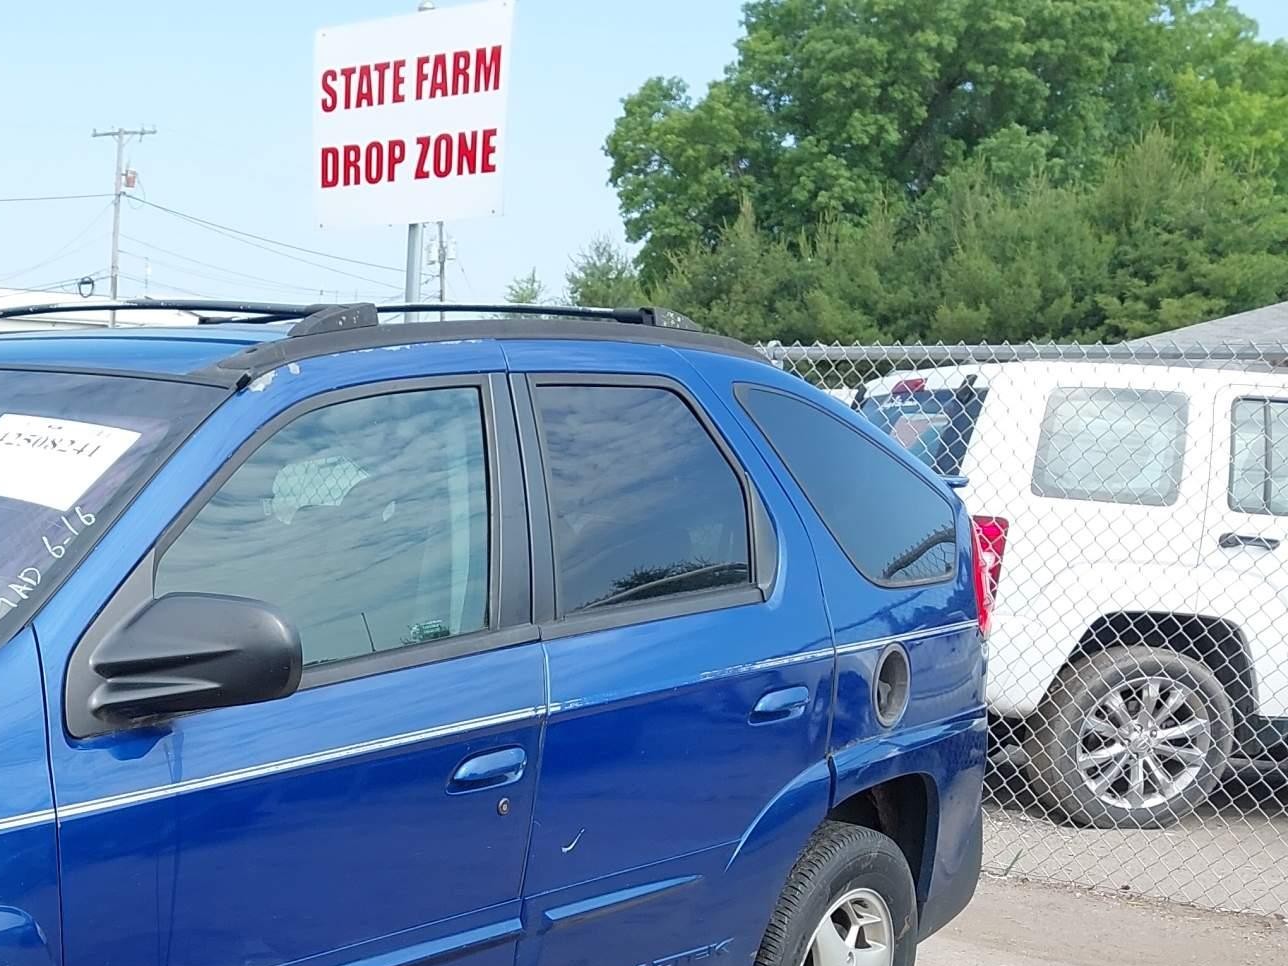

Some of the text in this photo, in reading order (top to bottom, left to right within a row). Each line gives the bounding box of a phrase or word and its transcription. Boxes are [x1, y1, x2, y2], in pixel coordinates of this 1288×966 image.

[321, 45, 502, 113] STATE FARM
[321, 128, 498, 189] DROP ZONE
[42, 506, 96, 559] 6-16
